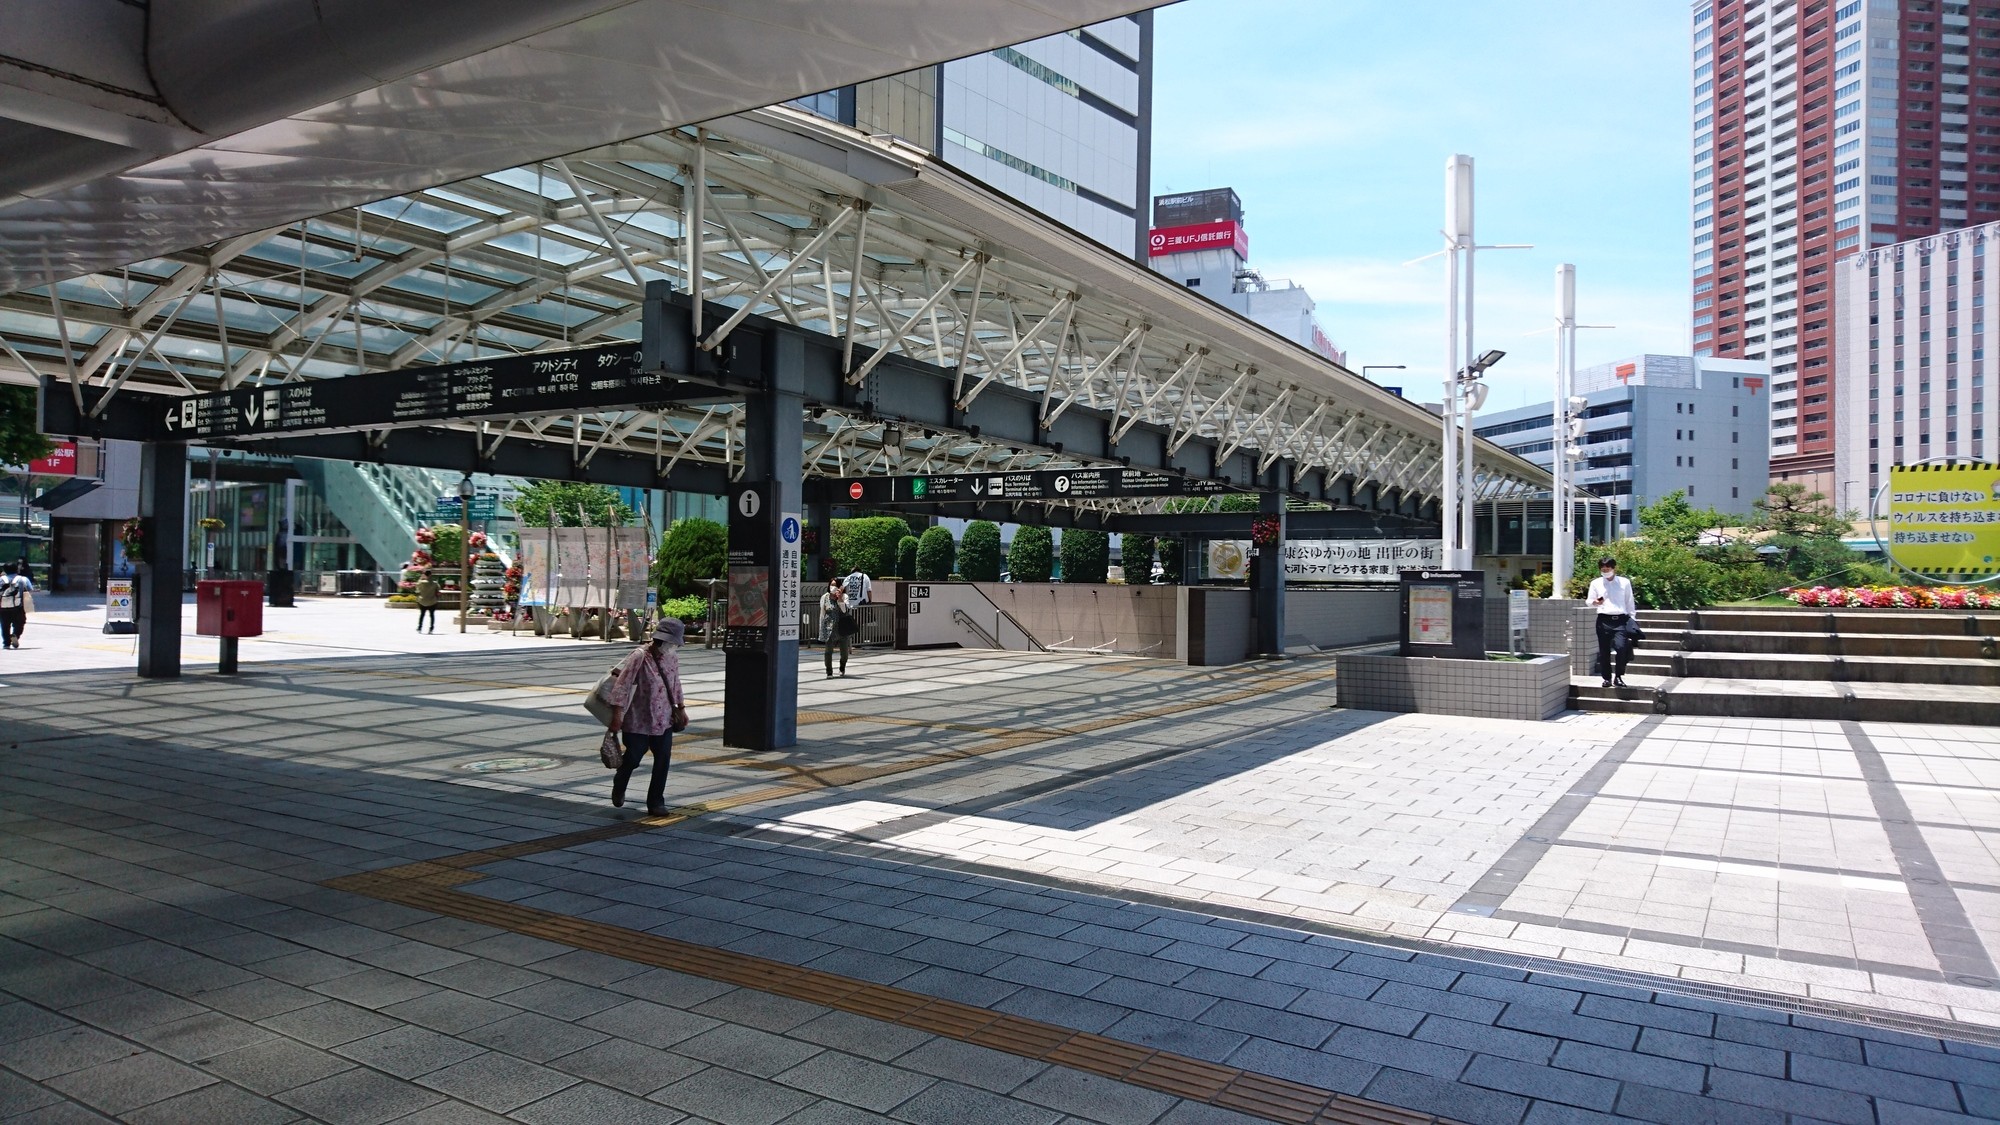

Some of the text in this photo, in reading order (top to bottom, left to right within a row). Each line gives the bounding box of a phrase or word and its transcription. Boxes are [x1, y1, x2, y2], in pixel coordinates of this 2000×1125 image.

[1167, 231, 1231, 245] 三菱UFJ信託銀行
[532, 358, 578, 373] アクトシティ
[550, 373, 578, 382] ACT City
[284, 387, 312, 398] スのりば
[1071, 471, 1101, 479] バス案内所
[1893, 491, 1985, 503] コロナに負けない
[1893, 512, 2000, 523] ウイルスを持ち込ま
[1893, 532, 1975, 544] 持ち込ませない
[1377, 546, 1434, 560] 出世の街
[1429, 571, 1462, 579] Information
[781, 549, 789, 618] 通行して下さい
[918, 588, 928, 596] A-2
[780, 628, 797, 637] 浜松市
